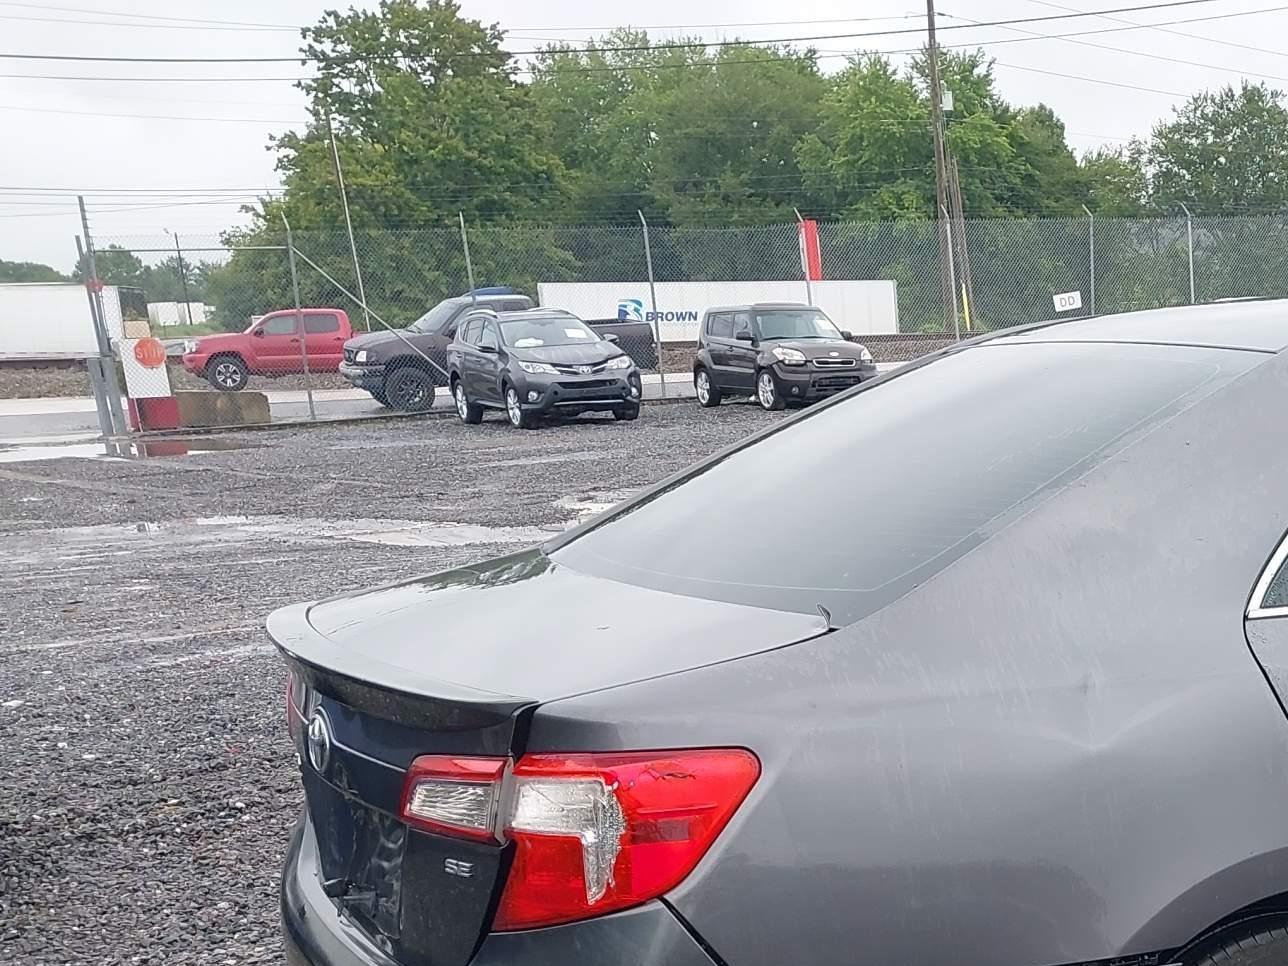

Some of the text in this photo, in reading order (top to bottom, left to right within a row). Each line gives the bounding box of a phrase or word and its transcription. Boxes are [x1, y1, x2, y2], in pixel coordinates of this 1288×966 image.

[1060, 295, 1075, 307] DD
[645, 311, 699, 322] BROWN
[444, 857, 474, 878] SE
